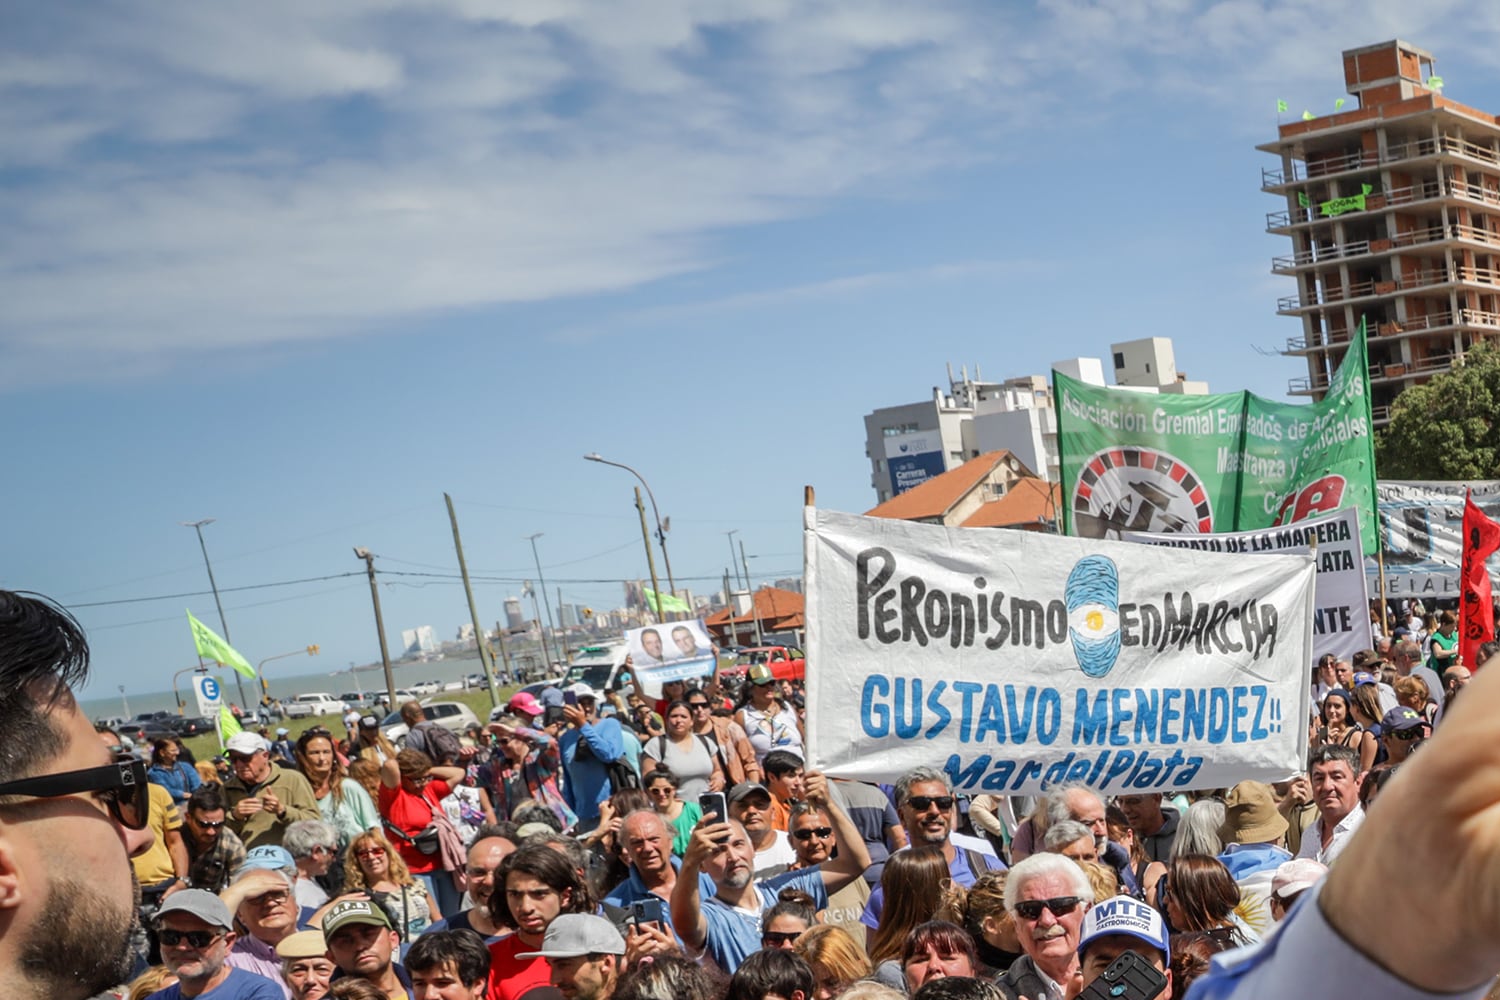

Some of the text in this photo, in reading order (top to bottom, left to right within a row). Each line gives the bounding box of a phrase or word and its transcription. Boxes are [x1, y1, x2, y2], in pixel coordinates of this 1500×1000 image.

[1063, 389, 1147, 432] Asociación
[1153, 407, 1214, 435] Gremial
[1218, 408, 1282, 442] Empeados
[1288, 418, 1308, 440] de
[1216, 446, 1287, 478] Maestranza
[1251, 530, 1273, 551] LA
[1275, 519, 1351, 549] MADERA
[204, 681, 216, 697] E
[861, 674, 1281, 747] GUSTAVO MENENDEZ!!
[944, 753, 1043, 791] Mar
[1099, 749, 1204, 791] Plata
[1095, 900, 1152, 922] MTE
